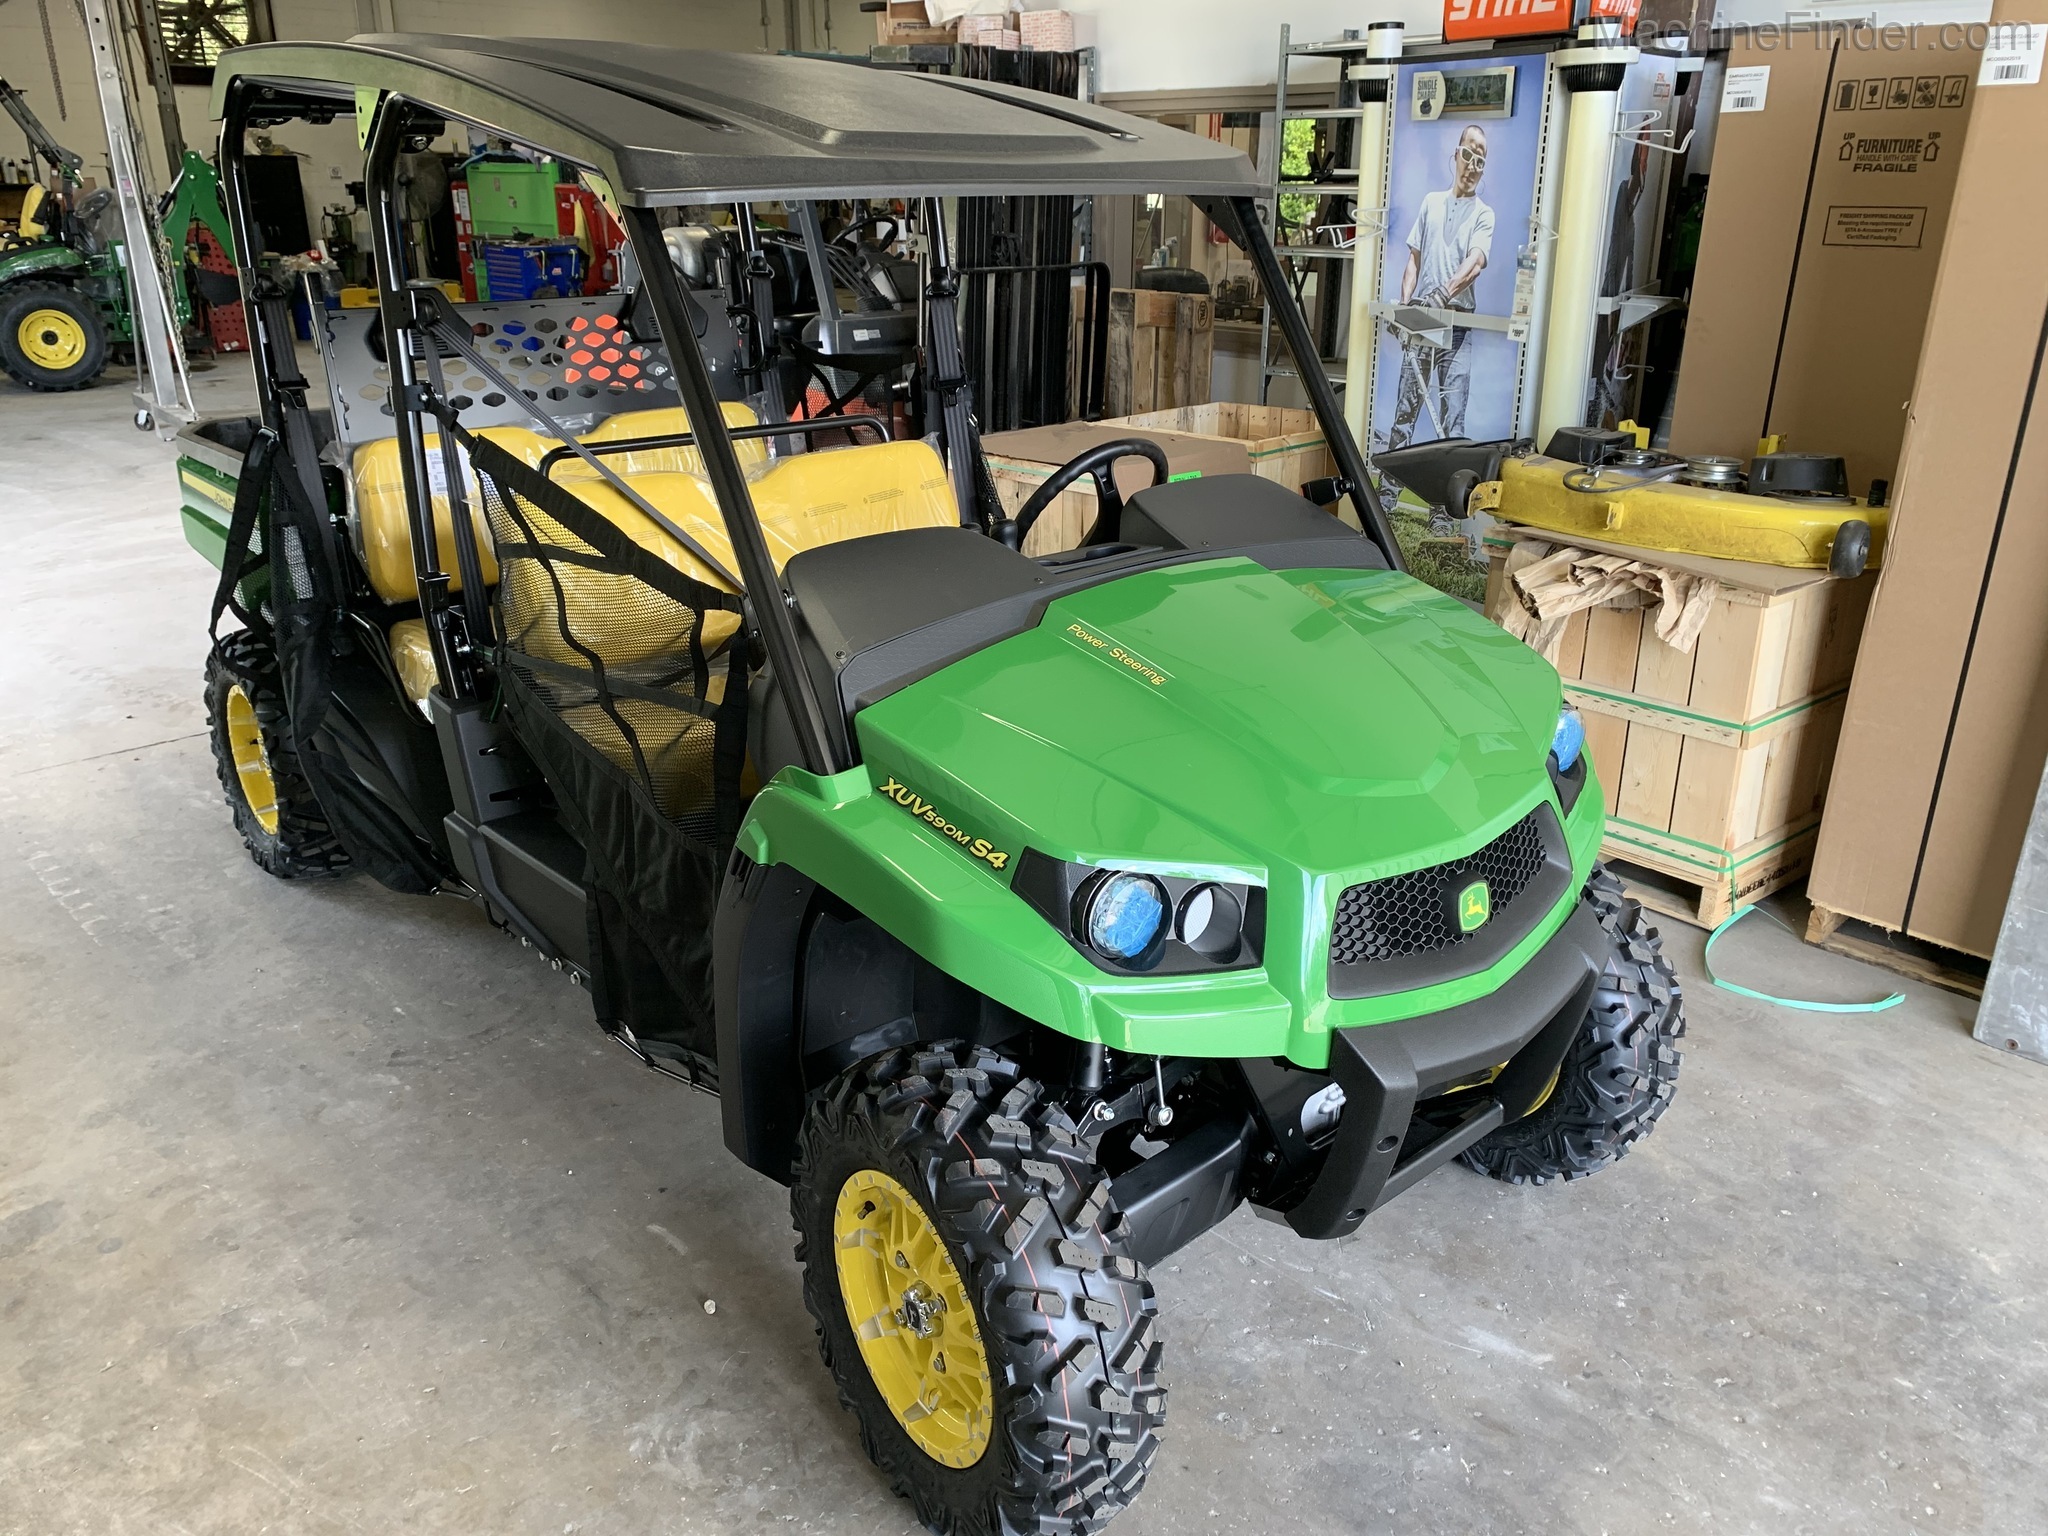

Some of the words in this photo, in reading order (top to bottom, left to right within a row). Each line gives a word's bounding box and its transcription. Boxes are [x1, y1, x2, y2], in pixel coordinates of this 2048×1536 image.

[1417, 79, 1438, 91] SINGLE
[1843, 132, 1856, 140] UP
[1928, 131, 1941, 140] UP
[1856, 139, 1923, 154] FURNITURE
[1856, 154, 1882, 162] HANDLE
[1883, 154, 1900, 162] WITH
[1901, 154, 1918, 162] CARE
[1853, 163, 1918, 173] FRAGILE
[1066, 623, 1109, 649] Power
[1109, 647, 1167, 686] Steering
[879, 776, 971, 845] XUV590M
[969, 838, 1009, 869] S4
